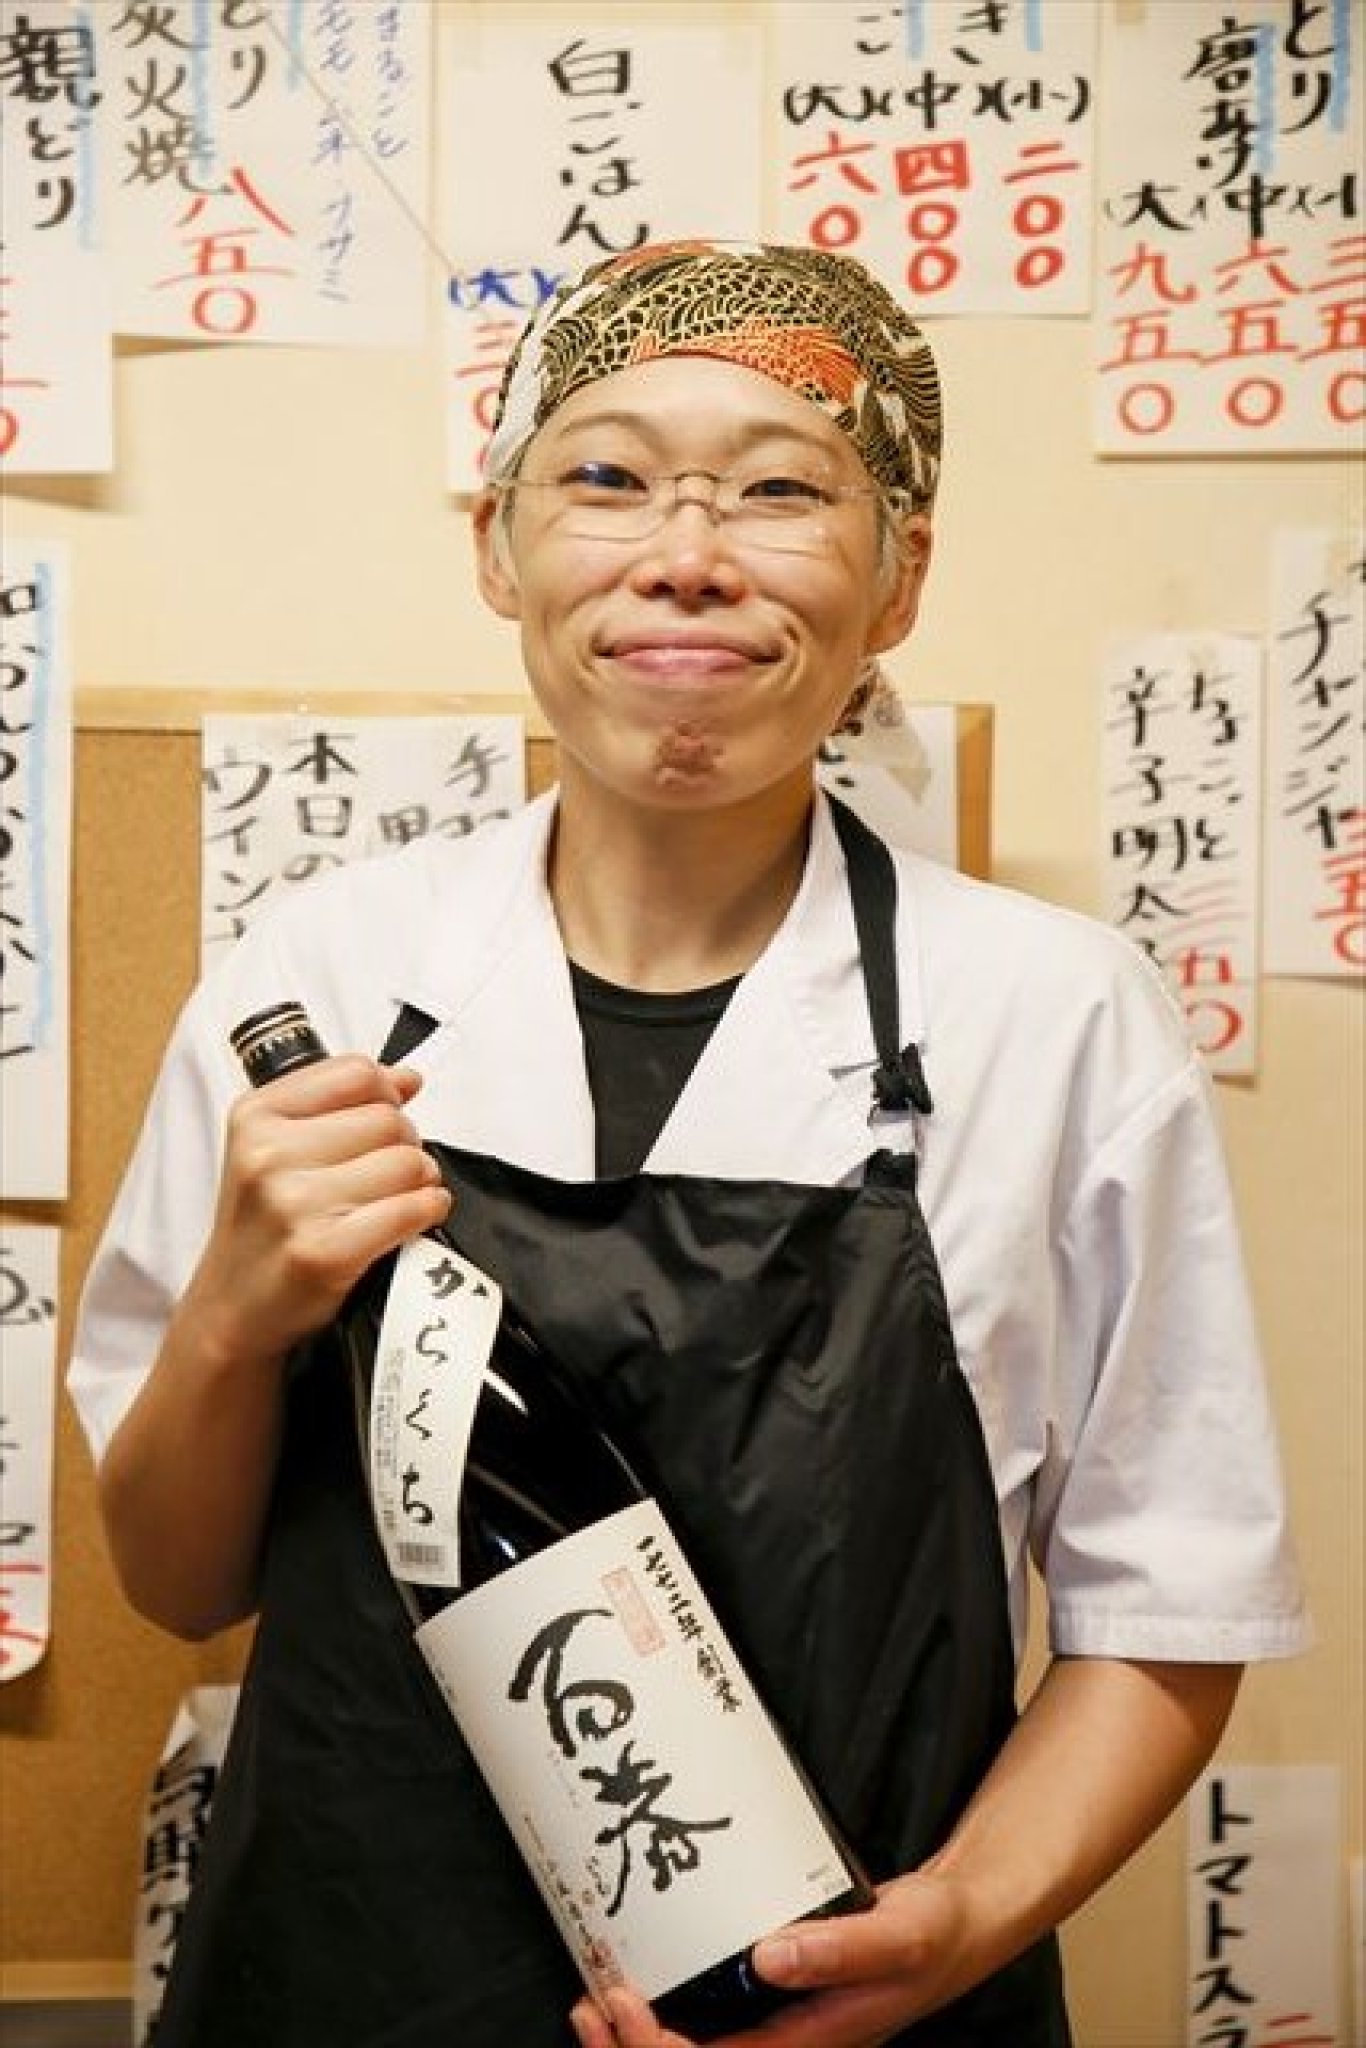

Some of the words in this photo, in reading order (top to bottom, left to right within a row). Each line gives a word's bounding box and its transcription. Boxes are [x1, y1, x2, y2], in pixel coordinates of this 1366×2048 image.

[547, 38, 650, 253] 白ごはん
[402, 1256, 490, 1527] からくち
